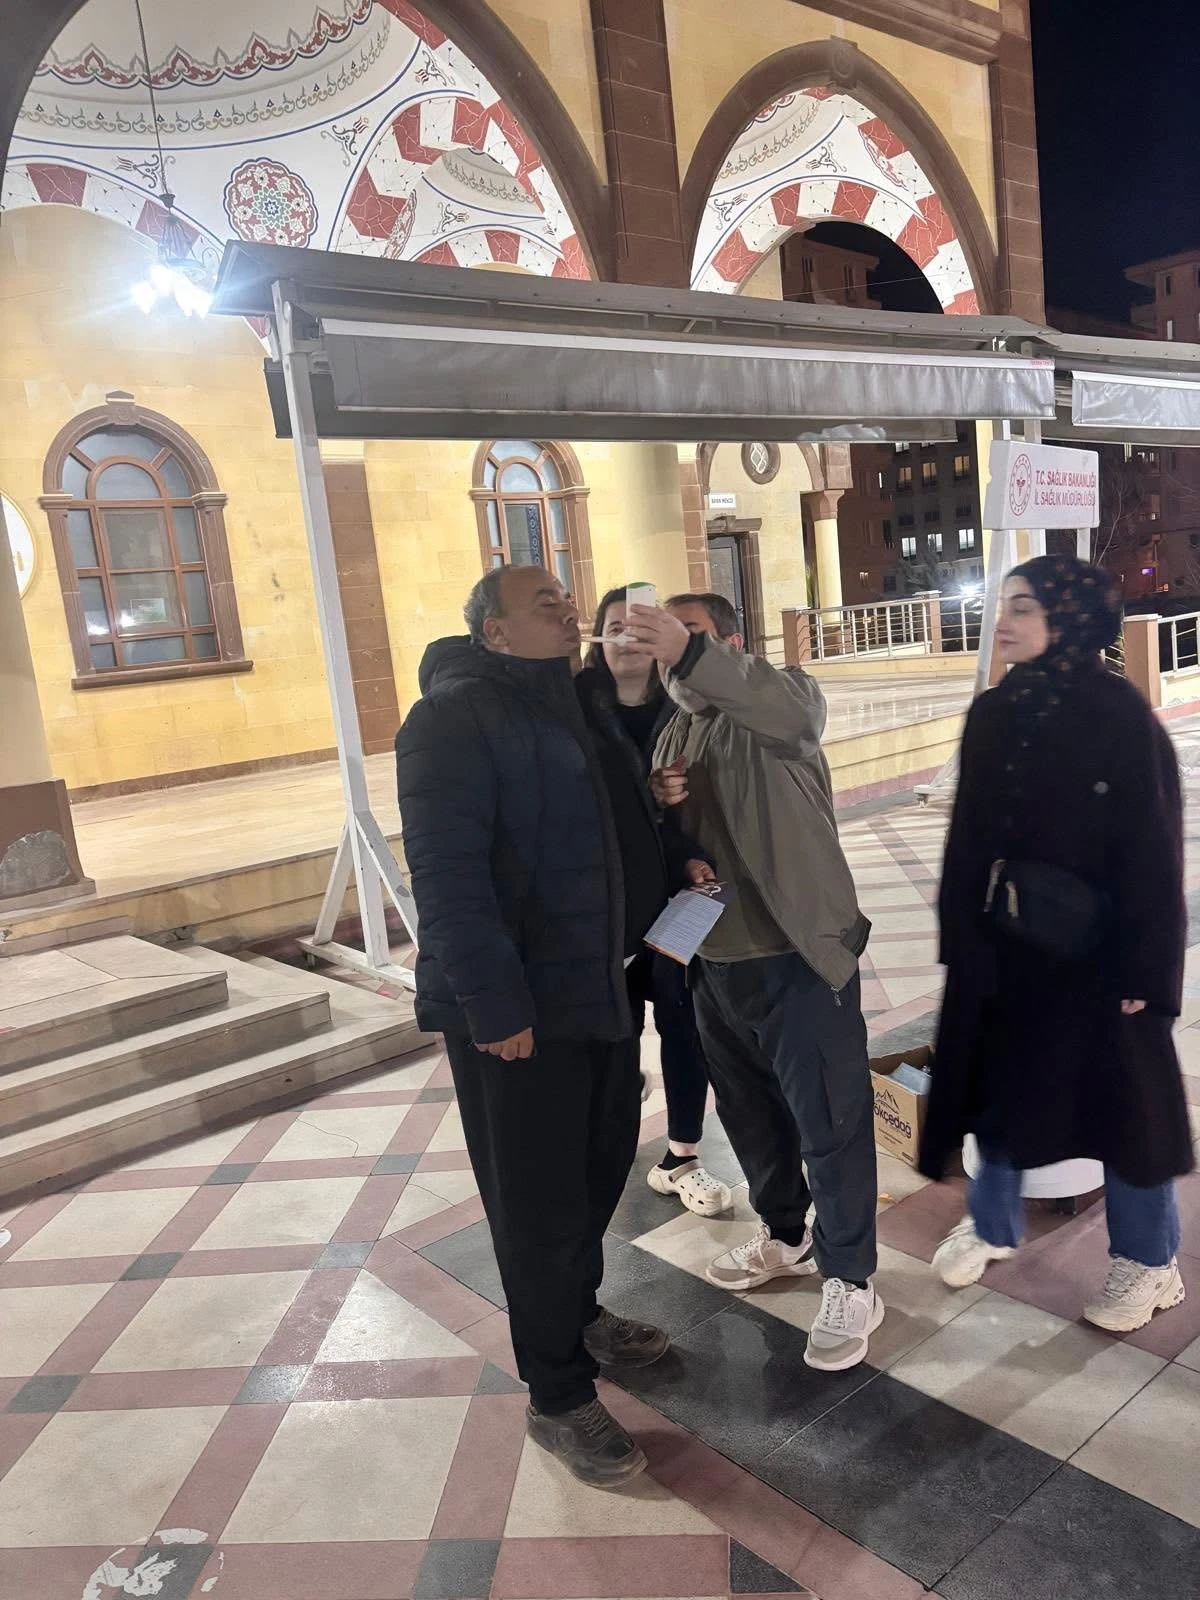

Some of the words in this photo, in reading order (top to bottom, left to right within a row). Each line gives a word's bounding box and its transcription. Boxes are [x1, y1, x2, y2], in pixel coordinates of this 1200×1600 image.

[1047, 468, 1067, 486] SAĞLIK
[1068, 472, 1096, 488] BAKANLIĞI
[1041, 488, 1061, 505] SAĞLIK
[873, 1102, 912, 1139] ökçedağ
